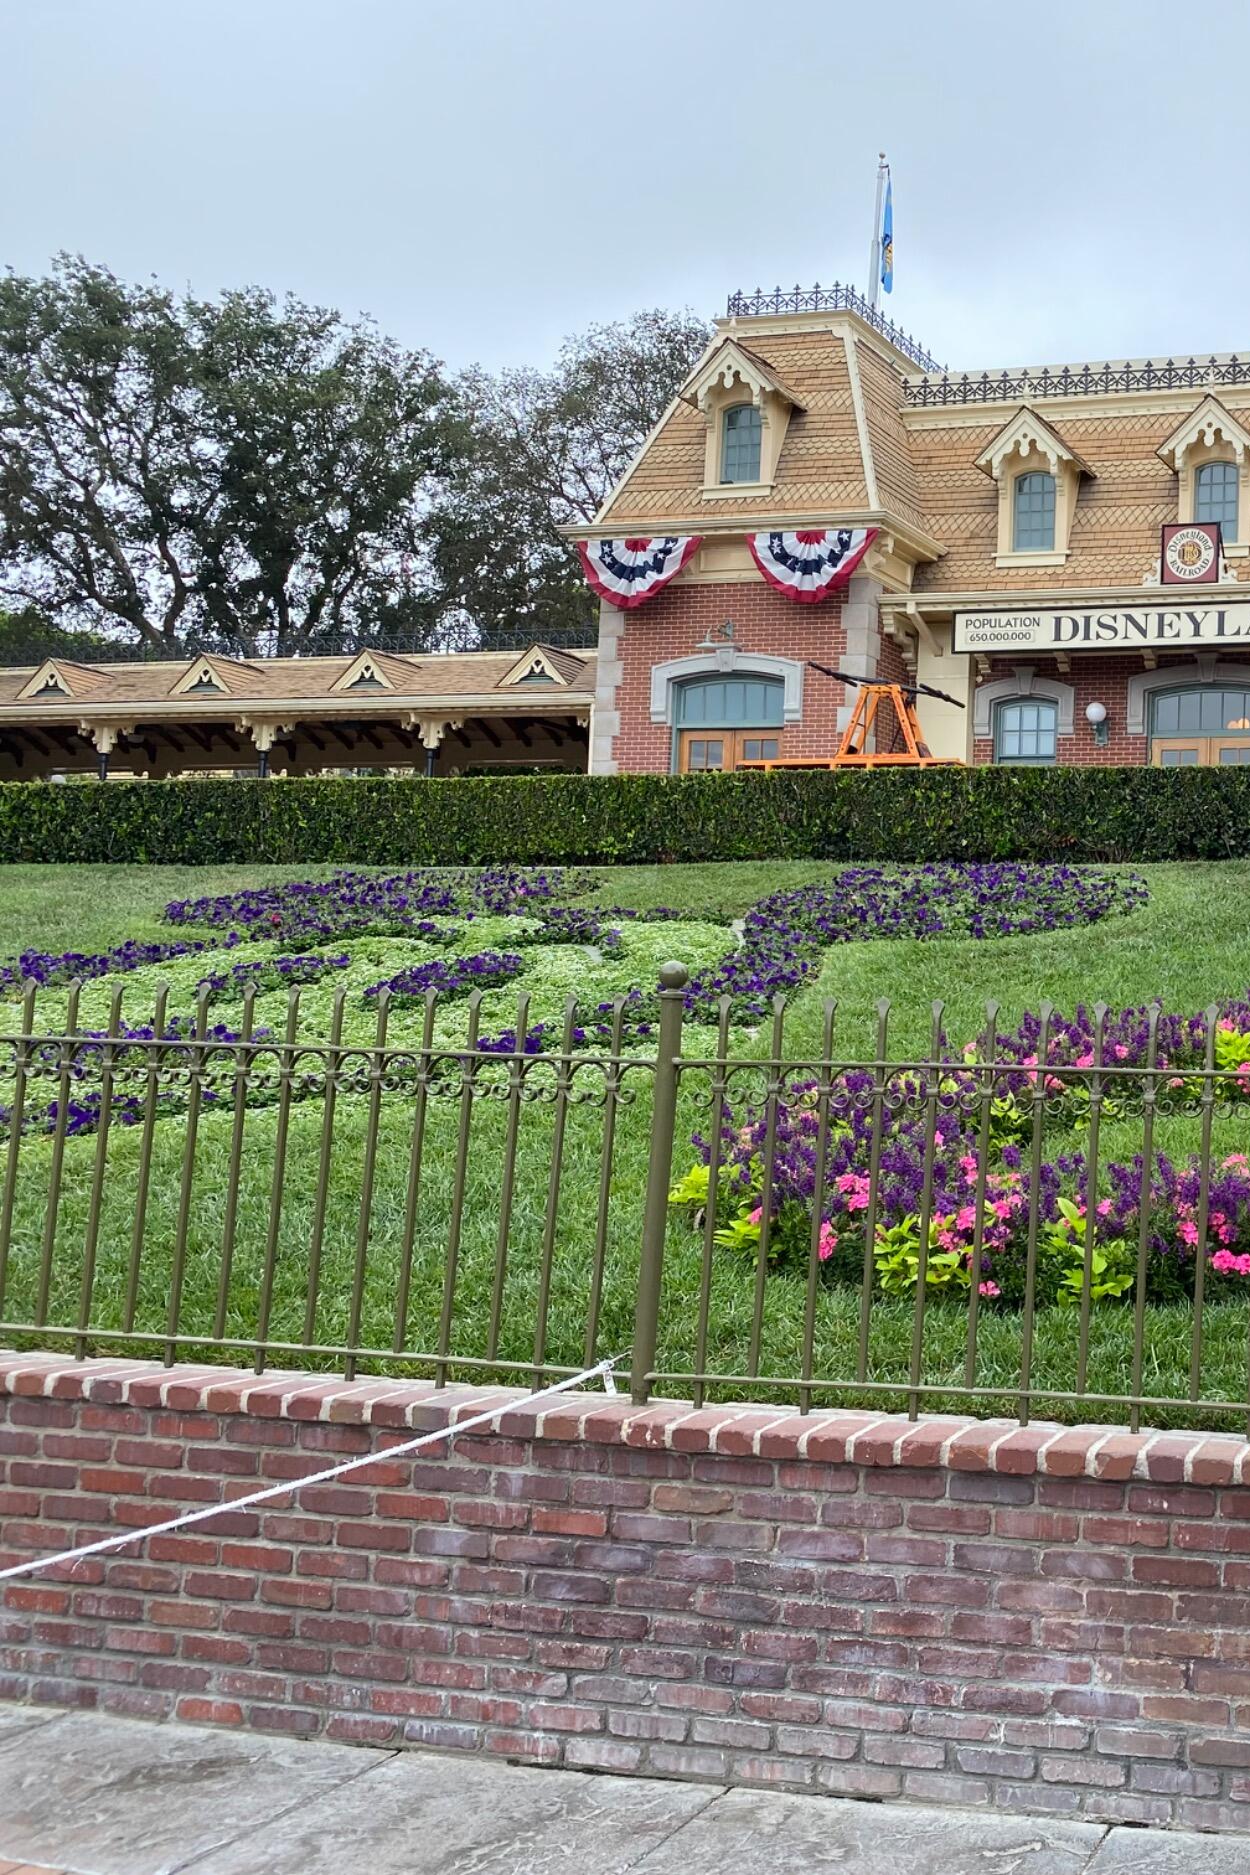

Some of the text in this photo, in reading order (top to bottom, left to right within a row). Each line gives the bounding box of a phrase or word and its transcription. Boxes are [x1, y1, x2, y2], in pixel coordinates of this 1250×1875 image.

[1168, 530, 1213, 553] Disneyland
[1169, 558, 1210, 577] RAILROAD
[965, 617, 1041, 630] POPULATION
